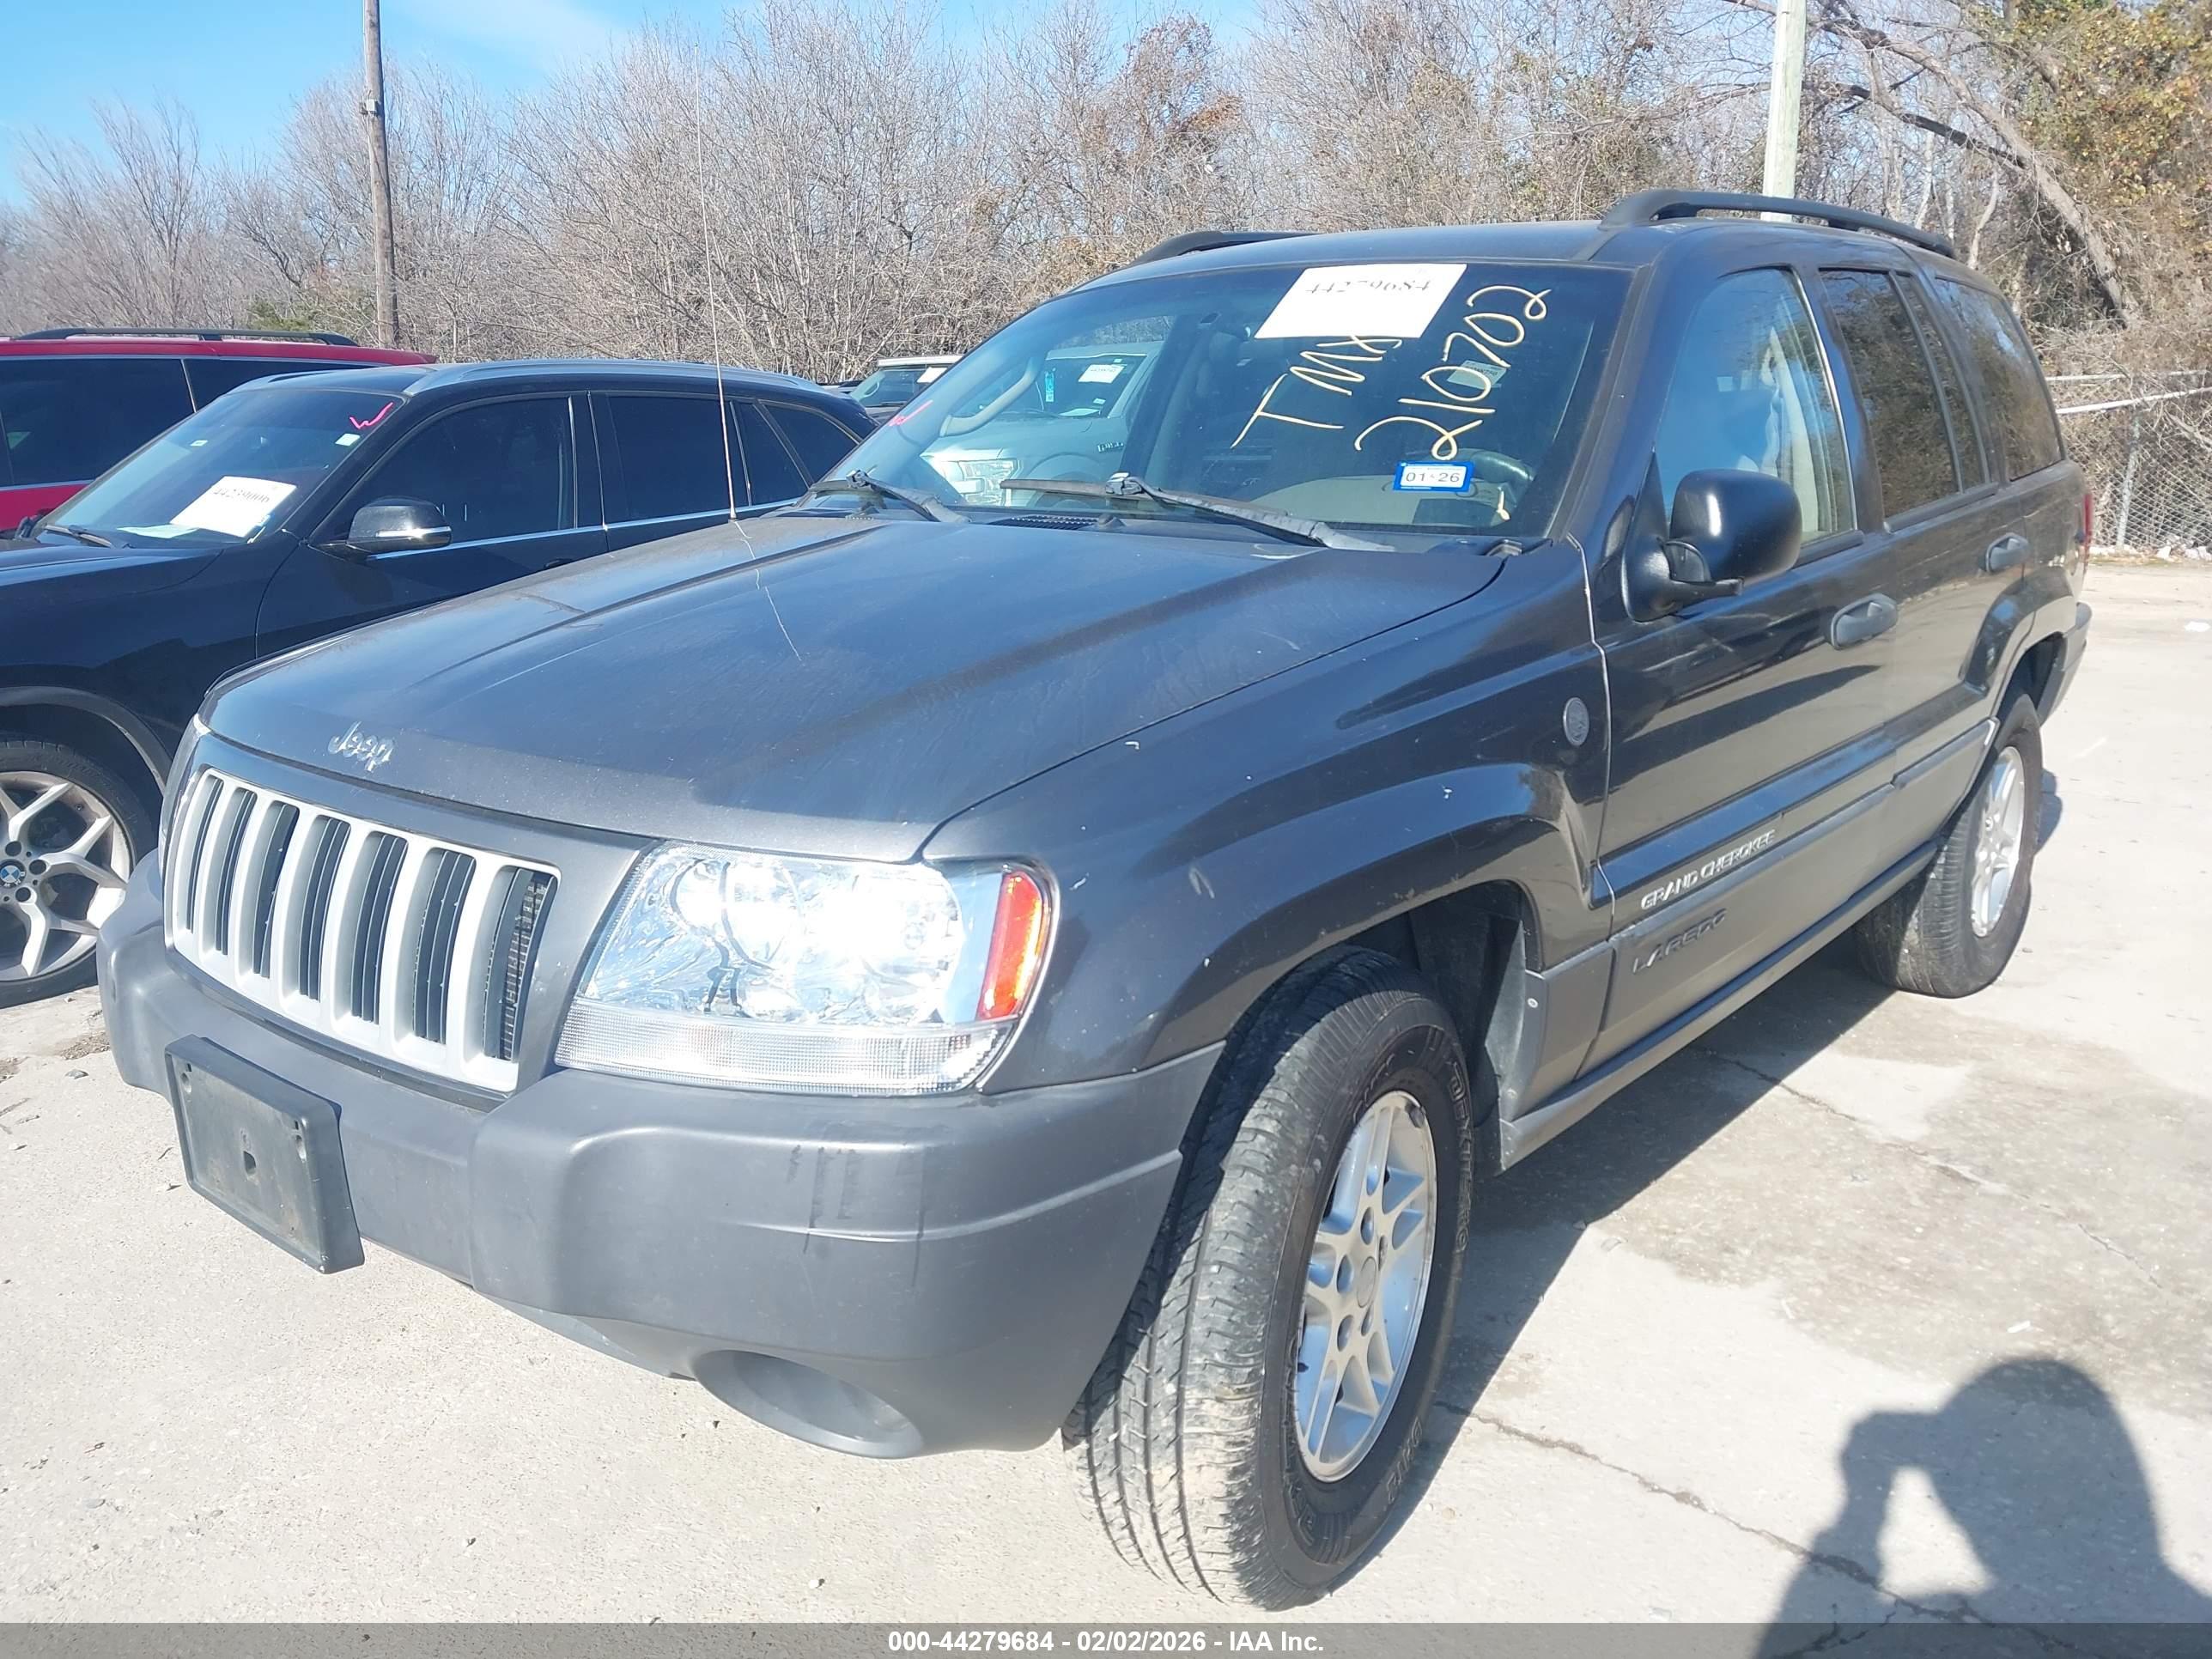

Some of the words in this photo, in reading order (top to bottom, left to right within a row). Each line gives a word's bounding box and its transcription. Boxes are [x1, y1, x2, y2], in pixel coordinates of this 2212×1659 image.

[1353, 284, 1553, 461] 210702
[1437, 472, 1461, 483] 26
[327, 720, 396, 773] Jeep
[1640, 870, 1698, 910] GRAND
[1700, 829, 1777, 879] CHEROKEE
[1632, 907, 1729, 975] LAREDO
